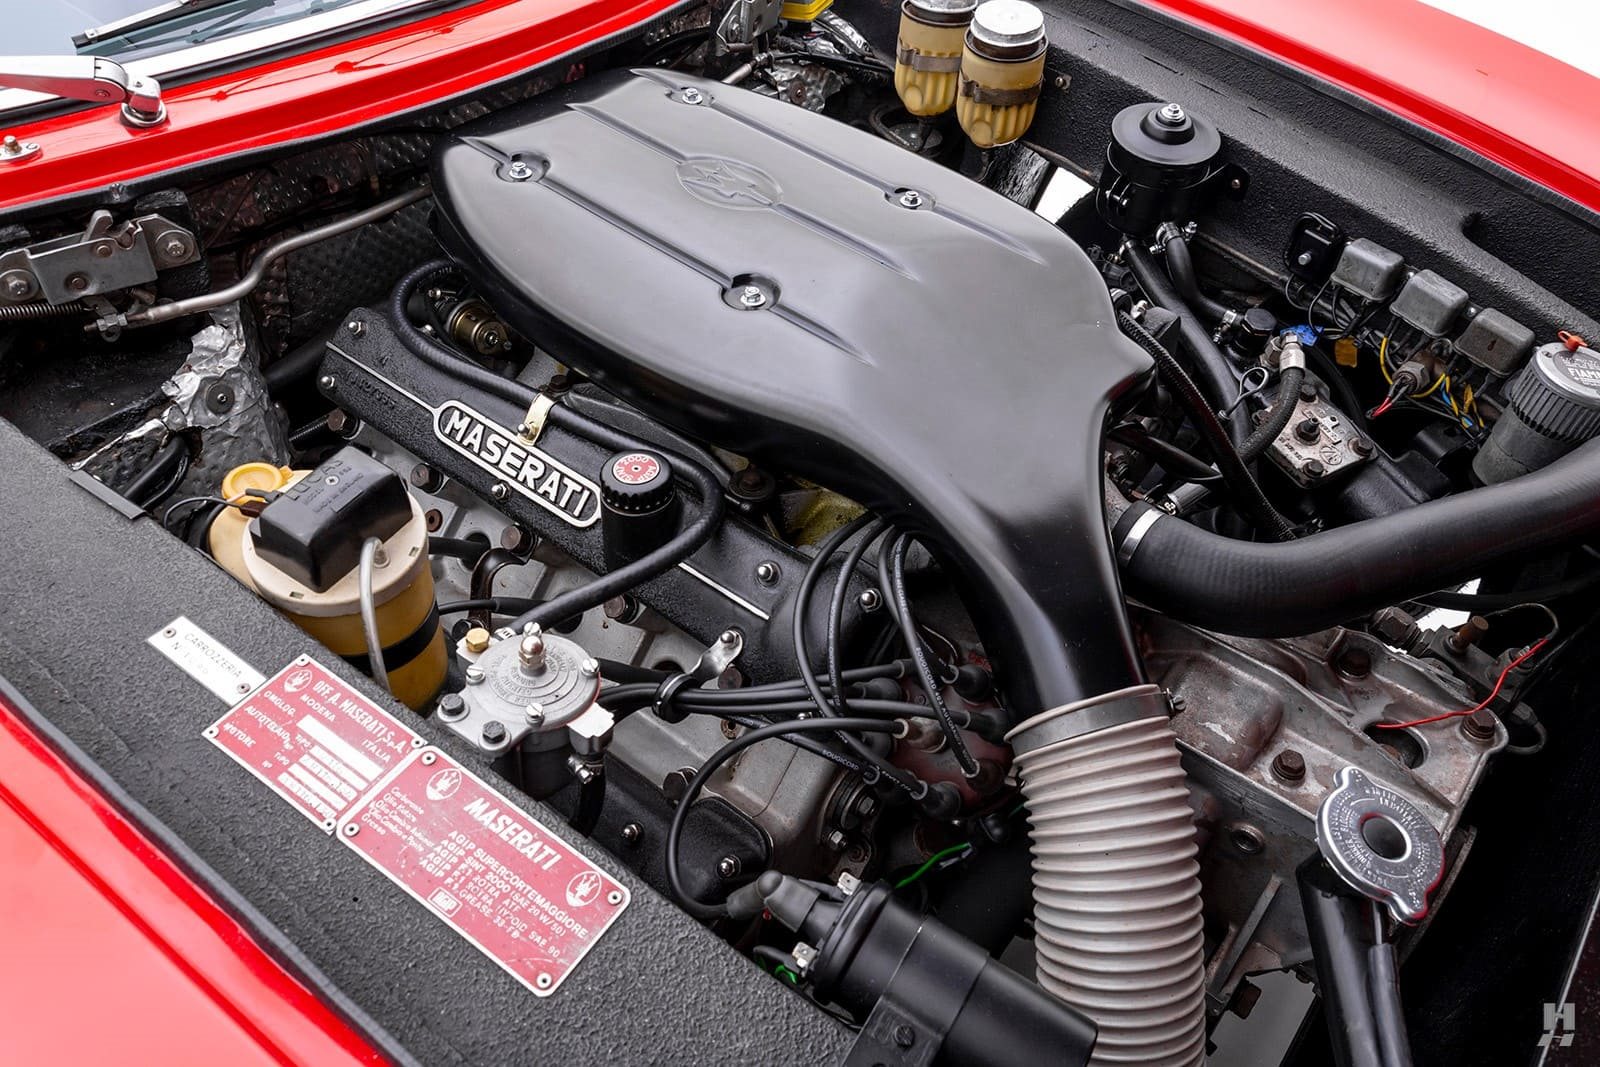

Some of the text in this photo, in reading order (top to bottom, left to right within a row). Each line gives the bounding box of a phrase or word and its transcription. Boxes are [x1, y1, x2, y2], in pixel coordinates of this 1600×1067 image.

[1568, 366, 1600, 378] FIAM
[444, 408, 591, 517] MASERATI
[182, 631, 244, 678] CARROZZERIA
[223, 722, 256, 747] MOTORE
[300, 694, 336, 722] MODENA
[361, 739, 391, 763] ITALIA
[312, 680, 334, 698] OFF.
[339, 699, 387, 737] MASERATI
[464, 798, 560, 869] MASERATI
[419, 858, 445, 877] AGIP
[459, 889, 493, 917] GREASE
[426, 852, 451, 870] AGIP
[528, 930, 547, 947] SAE
[547, 945, 561, 958] 90
[433, 845, 458, 863] AGIP
[502, 898, 521, 912] ATF
[440, 839, 466, 856] AGIP
[464, 855, 485, 873] SINT
[485, 871, 511, 893] 2000
[510, 890, 530, 908] (SAE
[447, 830, 587, 938] AGIP SUPERCORTEMAGGIORE
